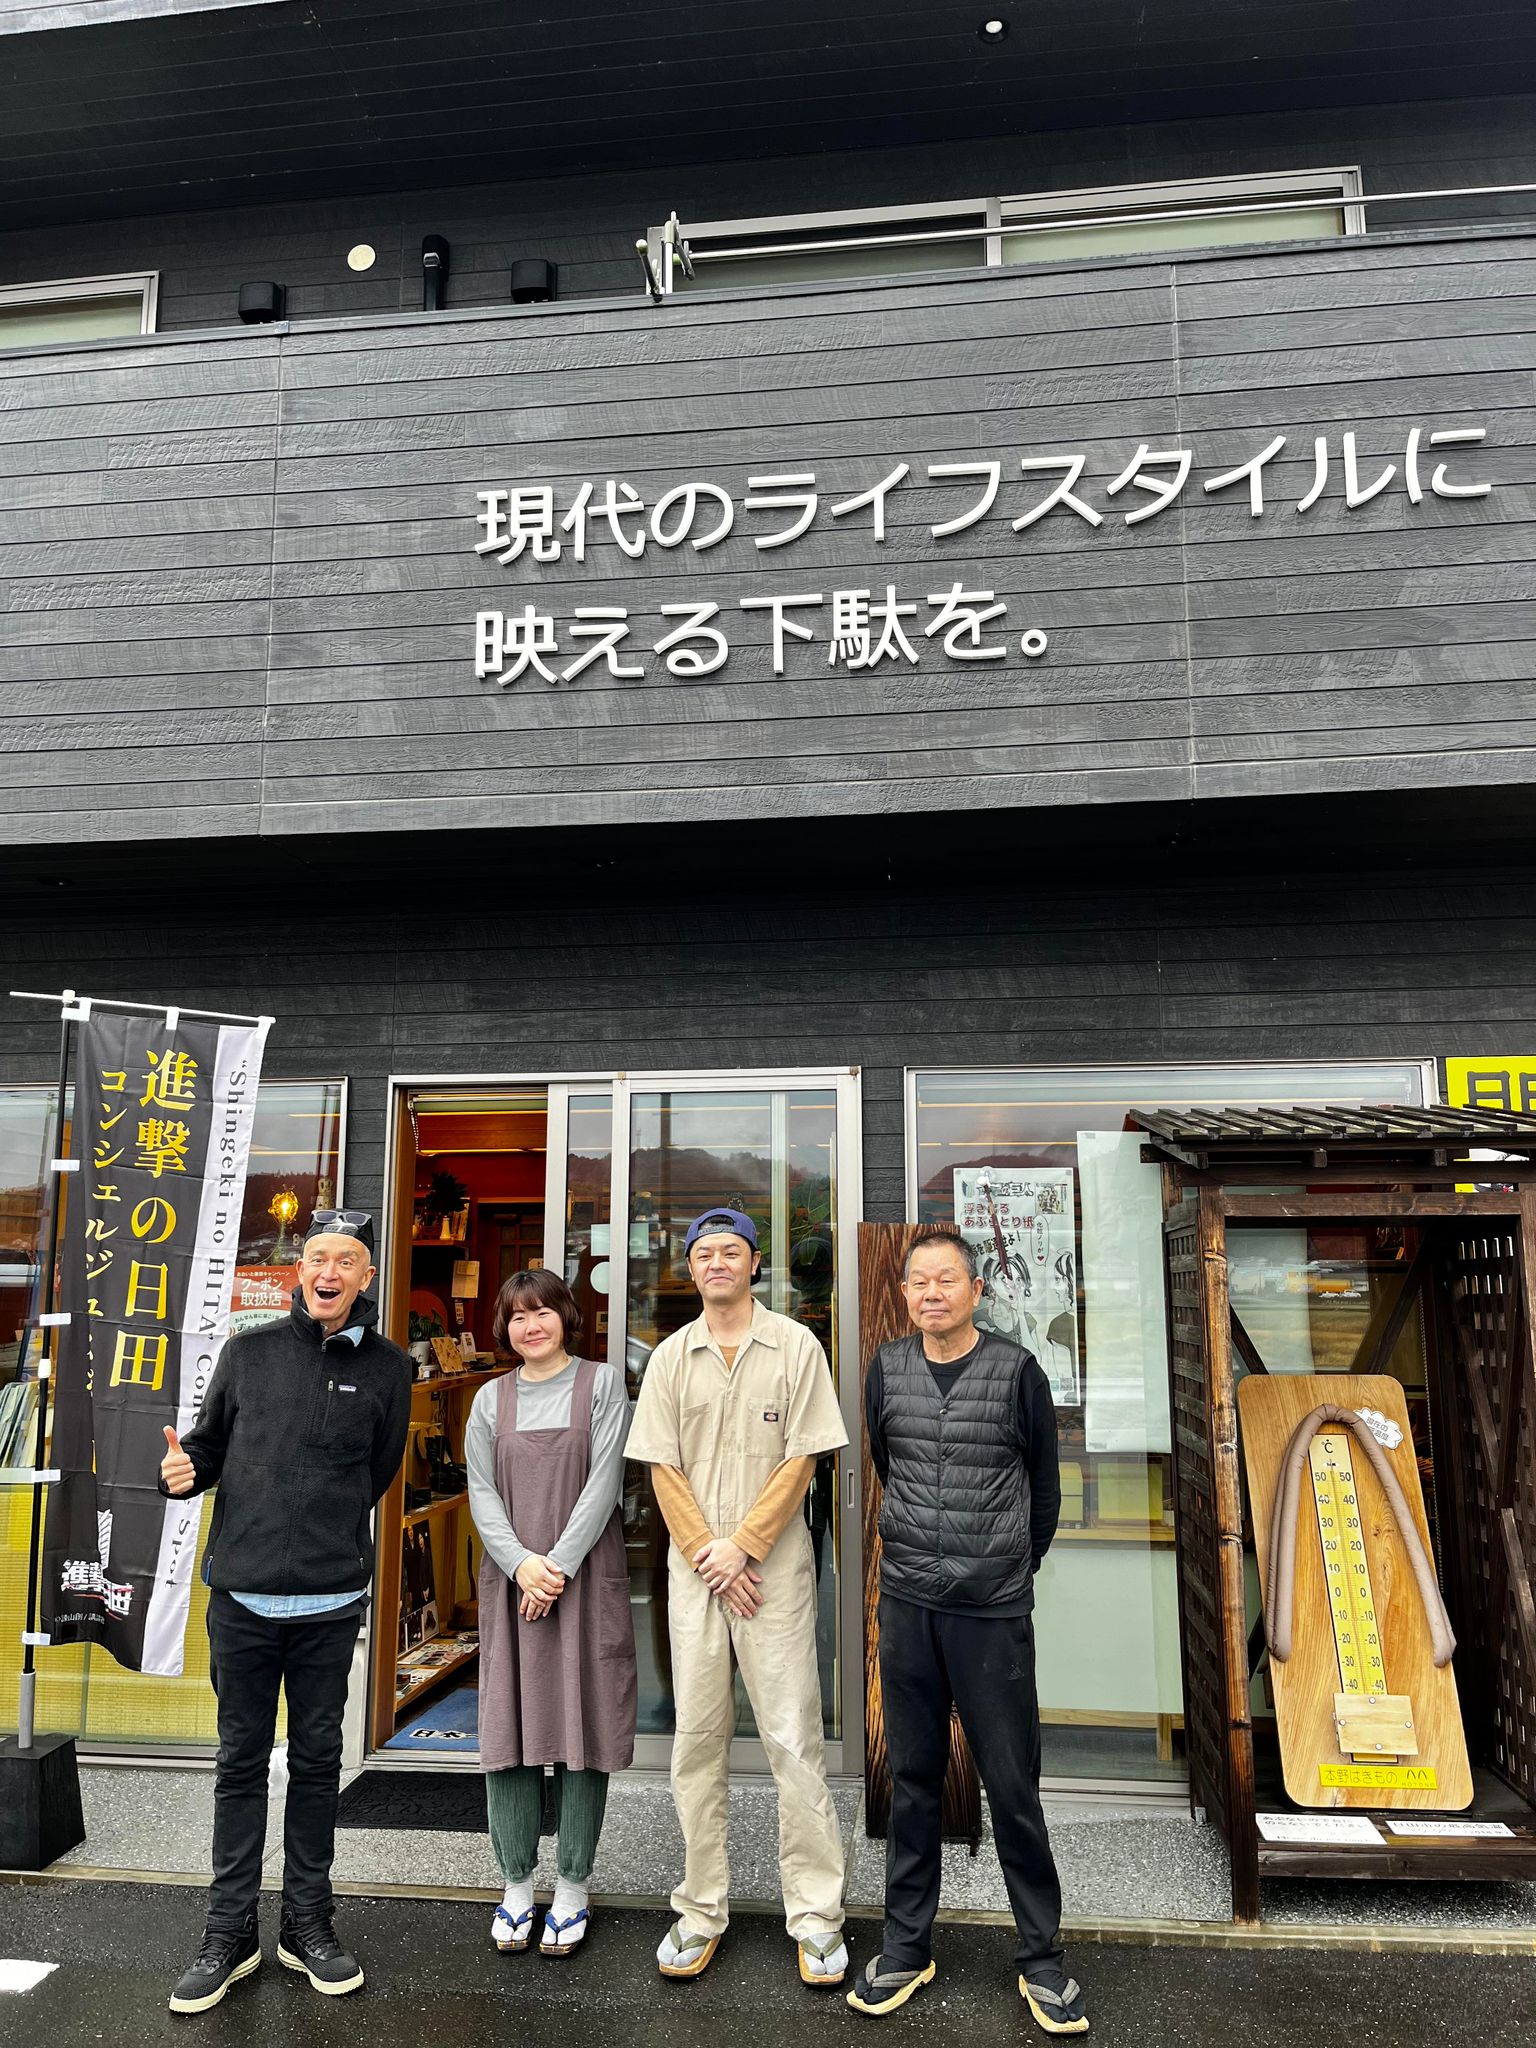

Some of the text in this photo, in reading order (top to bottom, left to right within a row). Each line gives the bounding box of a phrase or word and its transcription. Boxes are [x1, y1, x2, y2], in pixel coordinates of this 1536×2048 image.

[473, 427, 1492, 566] 現代のライフスタイルに
[473, 581, 1050, 687] 映える下駄を。
[110, 1048, 200, 1391] 進撃の日田
[212, 1210, 227, 1245] no
[241, 1277, 283, 1291] クーポン
[240, 1292, 283, 1306] 取扱店
[1315, 1472, 1351, 1482] 50 50
[1318, 1494, 1355, 1505] 40 40
[1321, 1517, 1359, 1528] 30 30
[1325, 1540, 1362, 1551] 20 20
[164, 1518, 191, 1589] Spot
[1329, 1563, 1365, 1574] 10 10
[1335, 1587, 1367, 1598] 0 0
[1335, 1610, 1373, 1621] -10 -10
[1338, 1633, 1376, 1644] -20 -20
[1342, 1656, 1380, 1667] -30 -30
[1345, 1679, 1384, 1690] -40 -40
[1325, 1768, 1398, 1785] 本野はきもの
